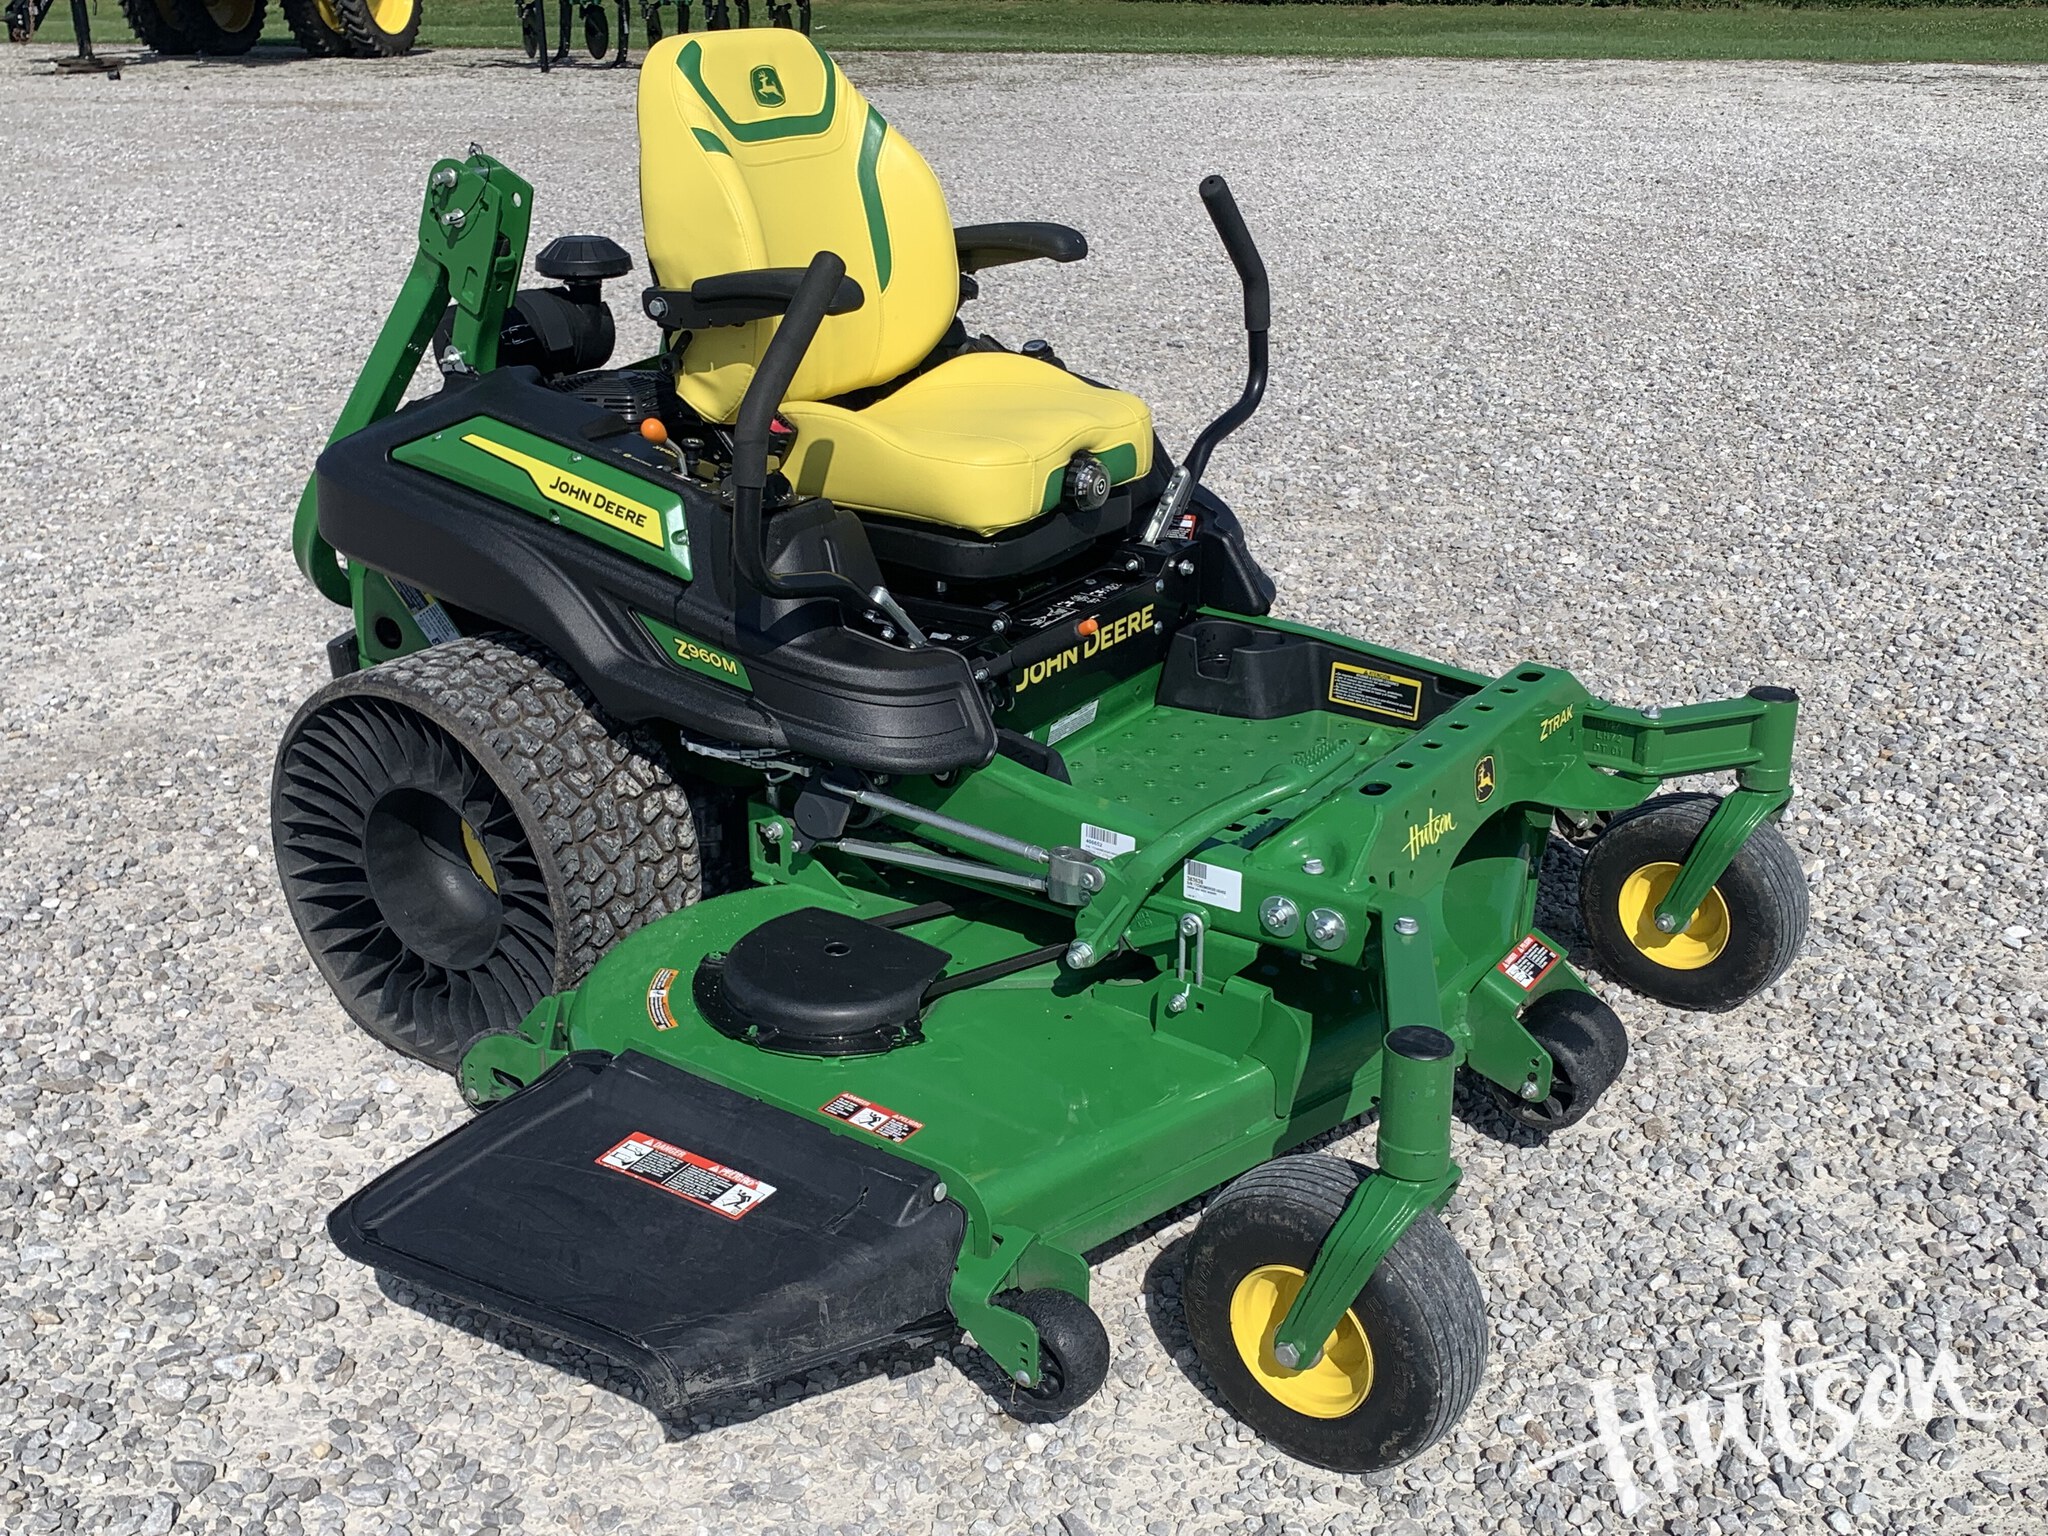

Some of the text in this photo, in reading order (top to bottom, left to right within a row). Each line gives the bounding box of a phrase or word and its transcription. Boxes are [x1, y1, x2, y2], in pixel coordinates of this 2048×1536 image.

[549, 476, 647, 528] JOHN DEERE
[673, 637, 738, 676] Z960M
[1015, 646, 1078, 693] JOHN
[1084, 603, 1155, 659] DEERE
[1539, 703, 1574, 743] ZTRAK
[1401, 808, 1458, 862] Hutson
[652, 1140, 687, 1158] DANGER
[718, 1166, 757, 1187] PELIGRO
